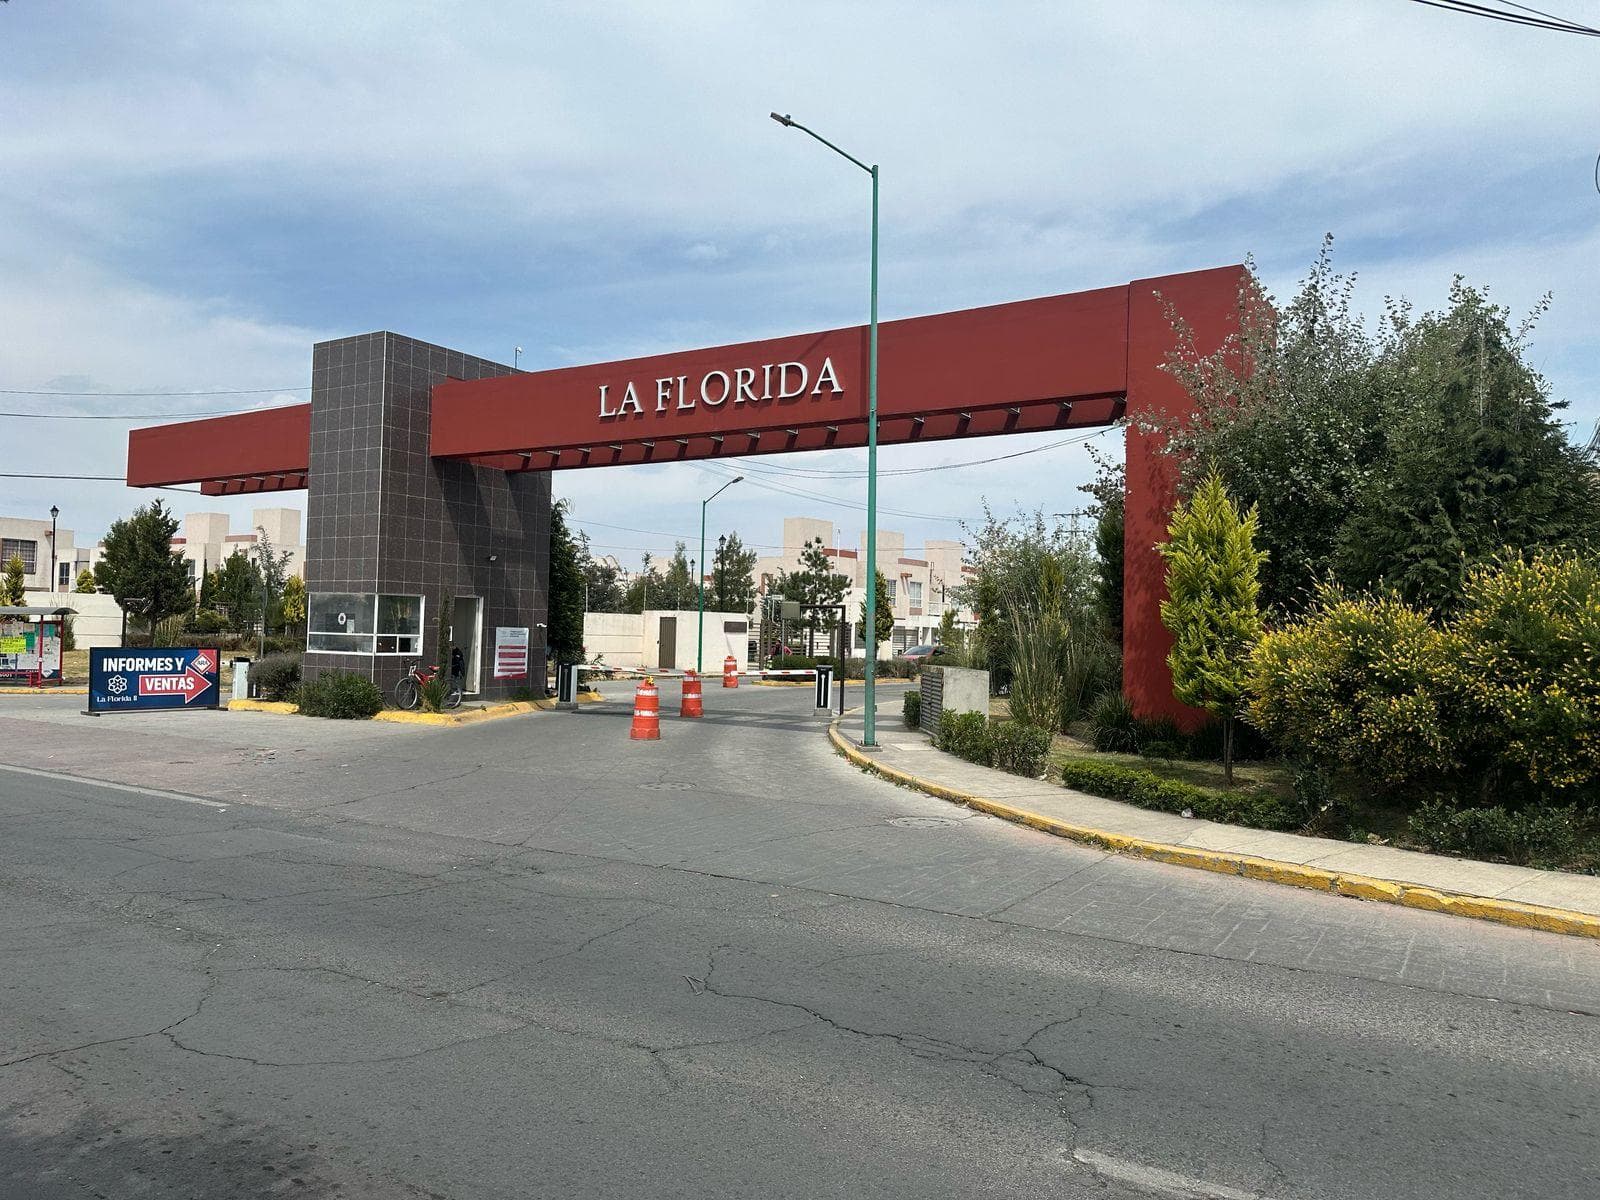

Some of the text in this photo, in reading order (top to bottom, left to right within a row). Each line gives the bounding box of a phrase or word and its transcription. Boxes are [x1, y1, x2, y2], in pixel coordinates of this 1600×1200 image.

[598, 357, 843, 418] LA FLORIDA
[102, 657, 185, 672] INFORMES Y
[145, 677, 195, 691] VENTAS
[107, 695, 132, 703] Florida
